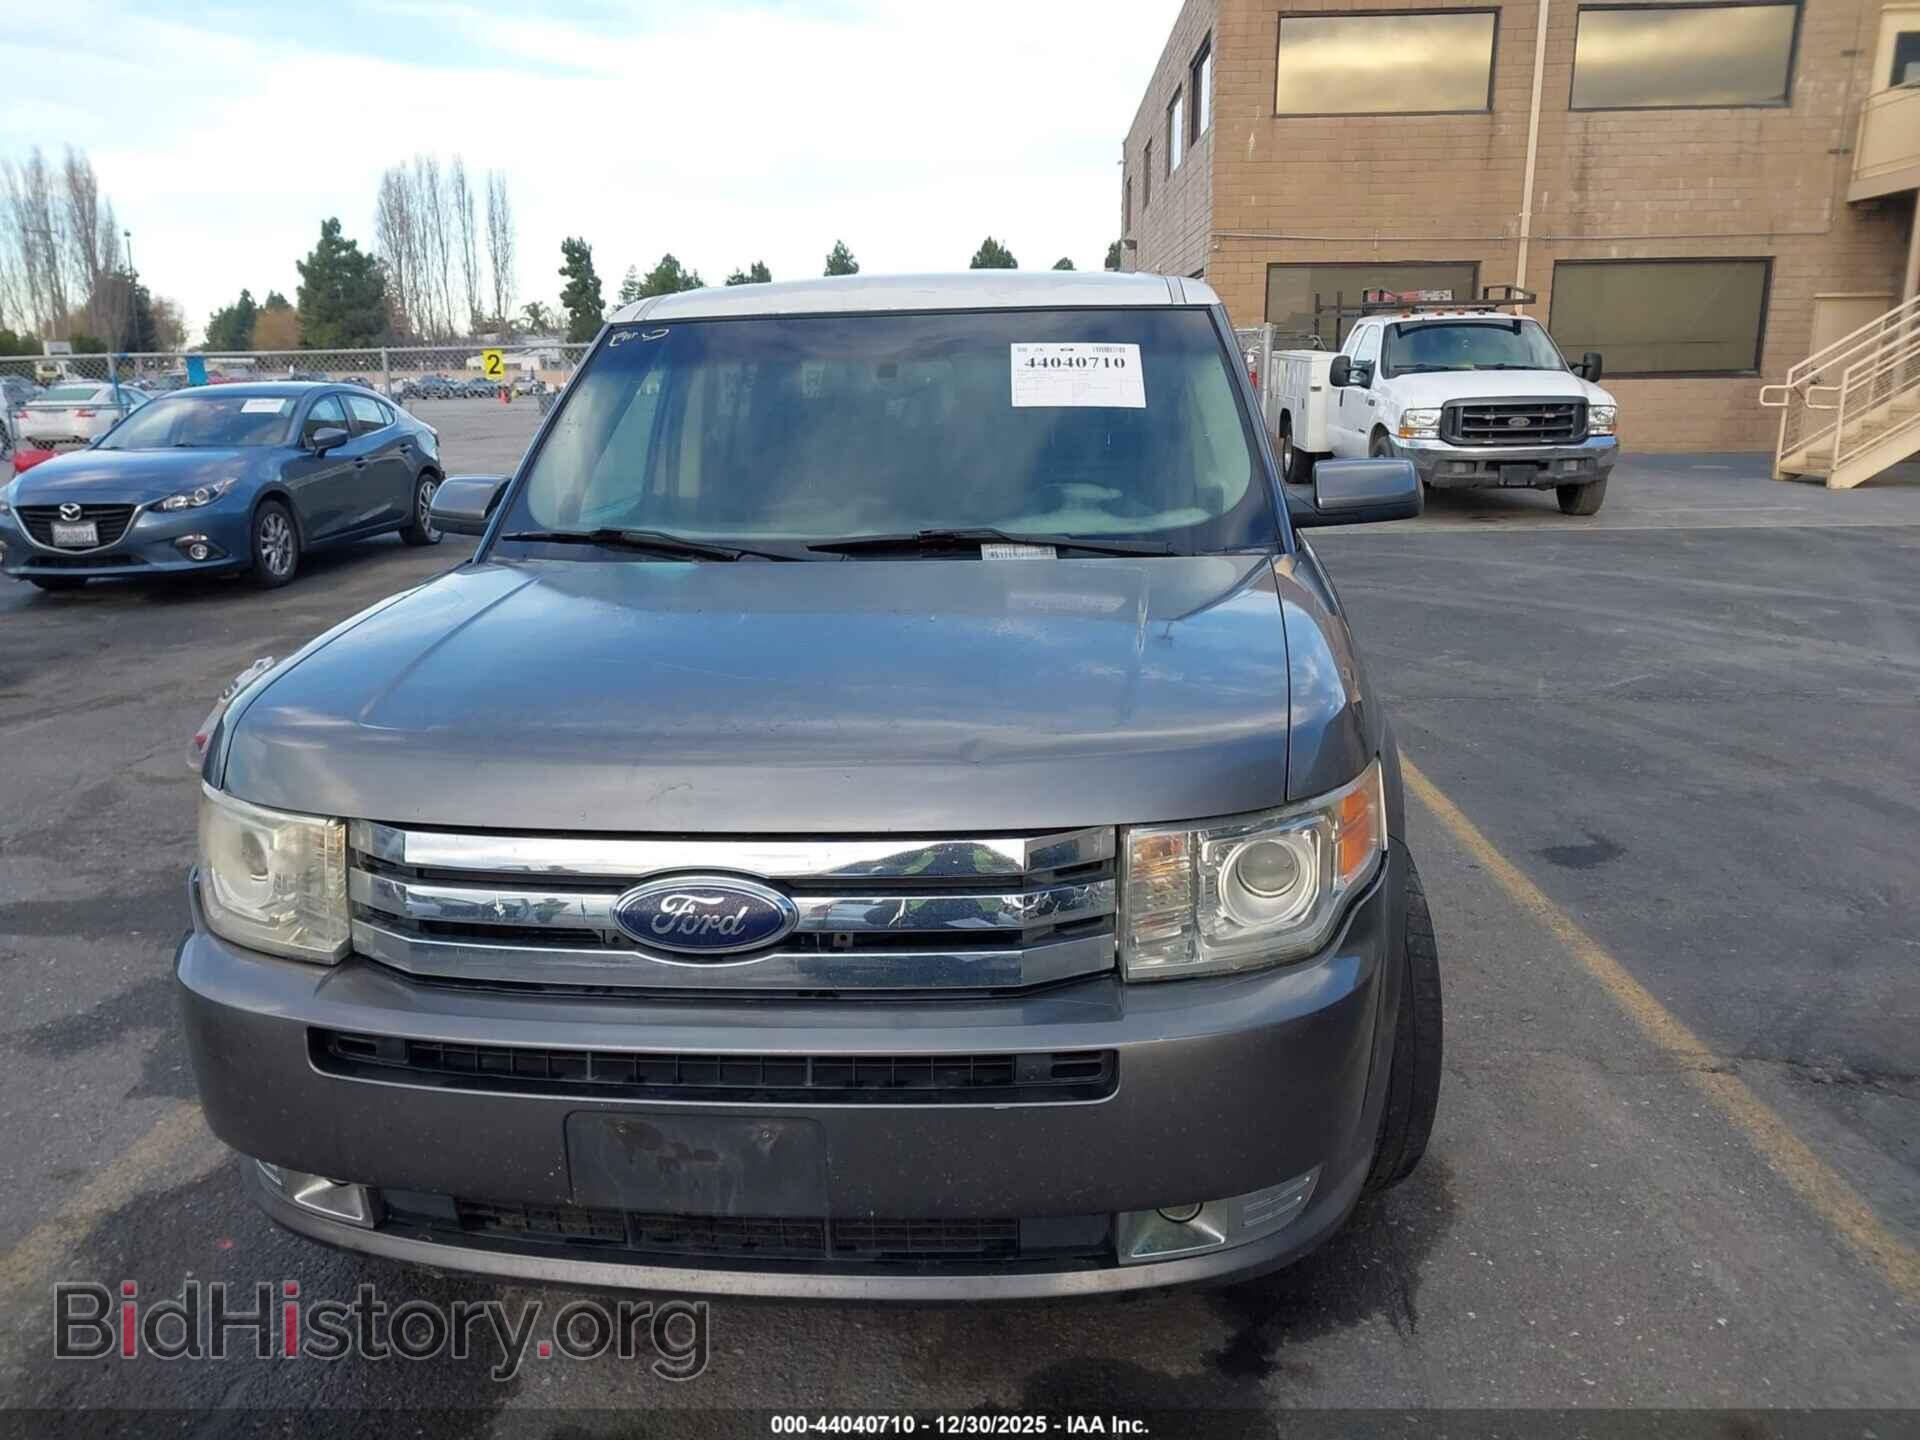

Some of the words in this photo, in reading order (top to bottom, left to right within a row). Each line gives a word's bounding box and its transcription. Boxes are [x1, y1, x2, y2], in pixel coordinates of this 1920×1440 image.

[487, 354, 502, 375] 2
[1024, 356, 1126, 369] 44040710
[651, 893, 748, 936] Ford
